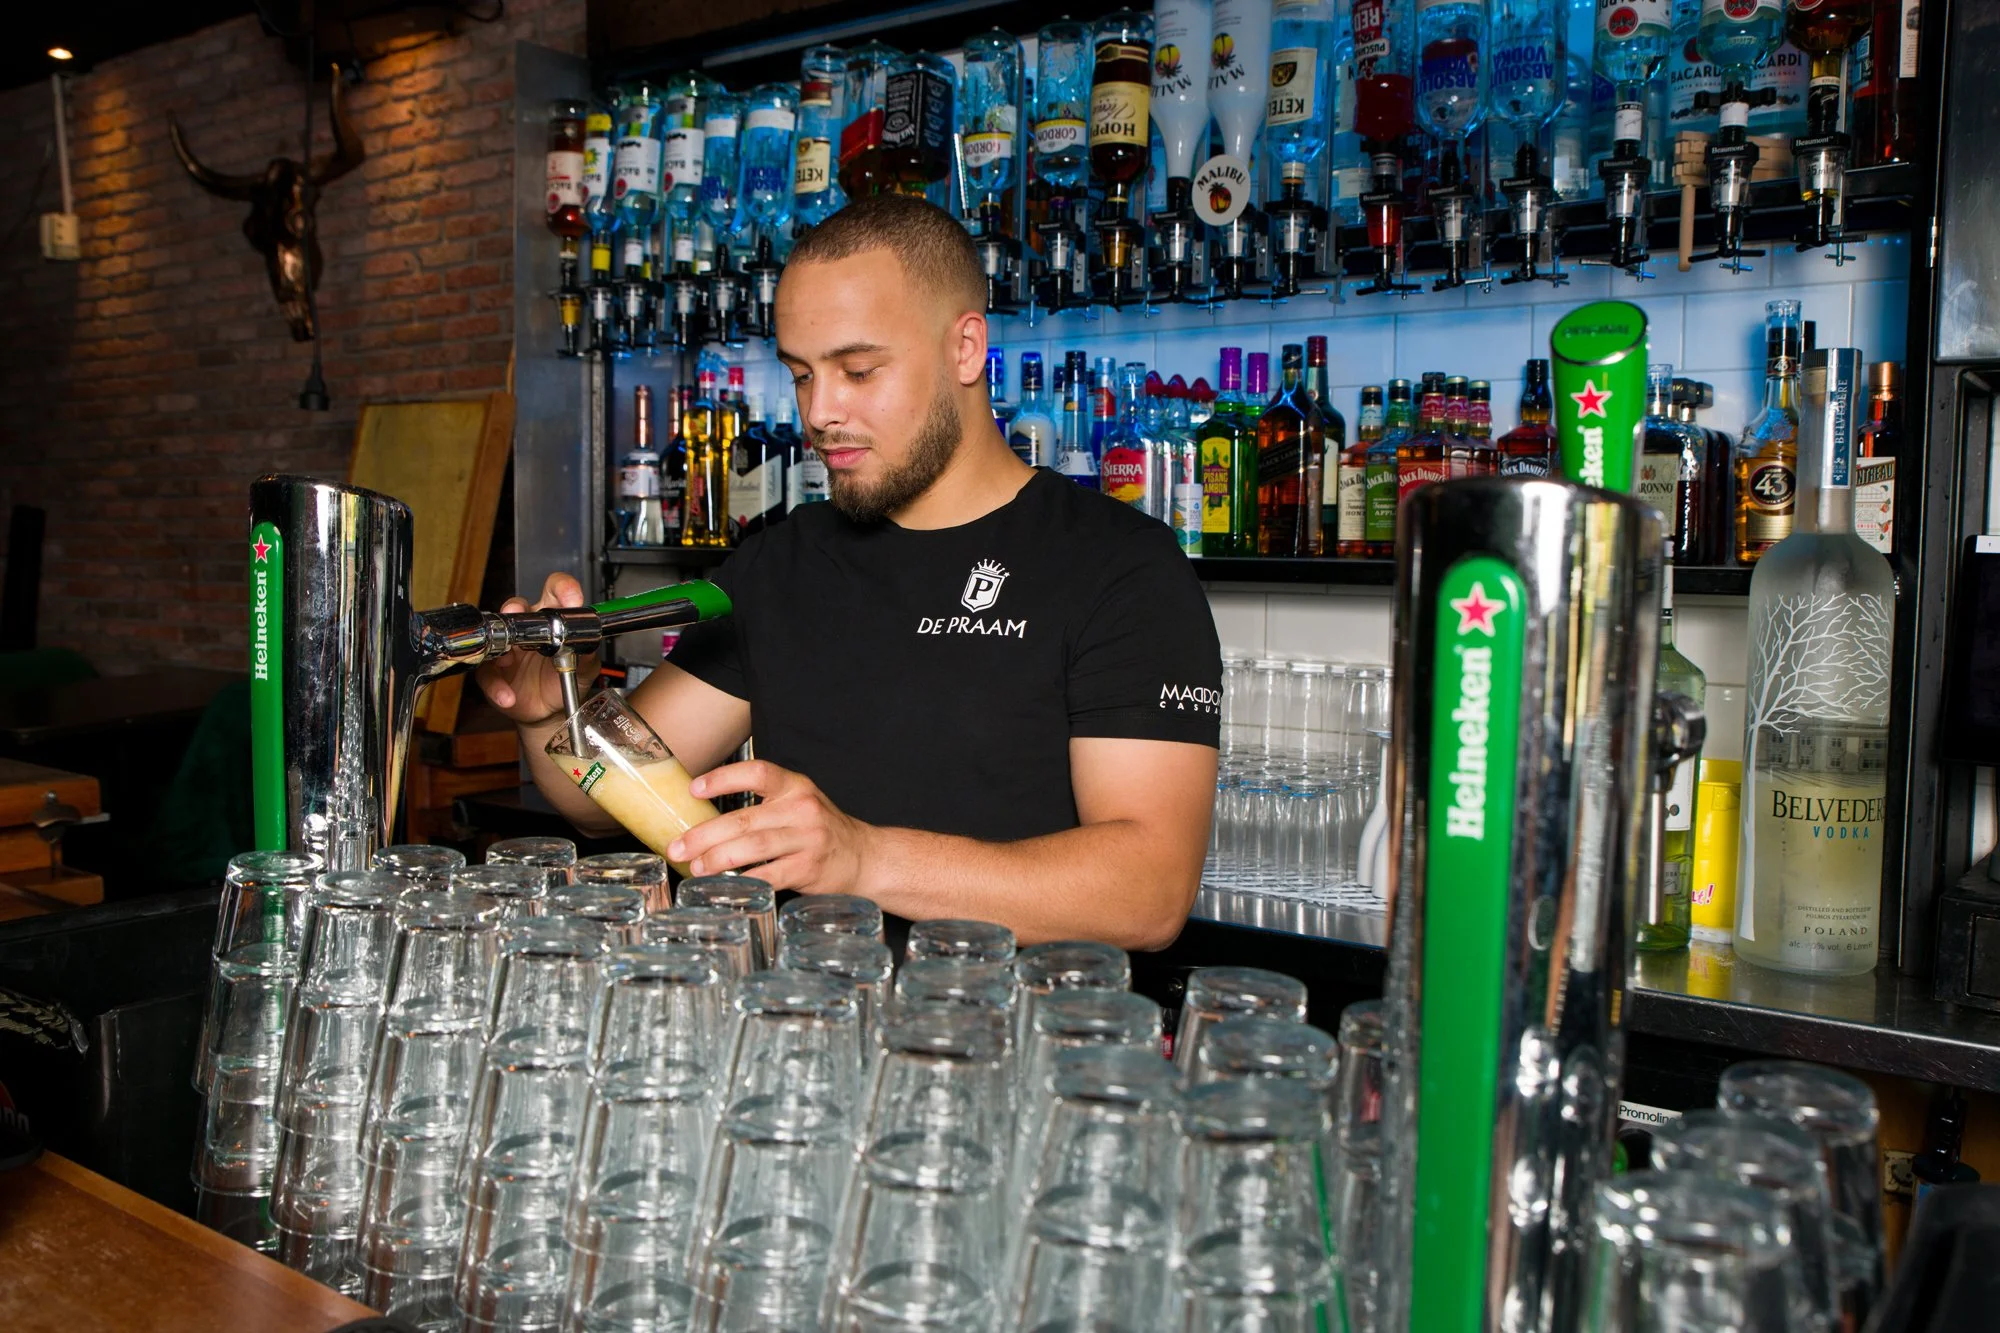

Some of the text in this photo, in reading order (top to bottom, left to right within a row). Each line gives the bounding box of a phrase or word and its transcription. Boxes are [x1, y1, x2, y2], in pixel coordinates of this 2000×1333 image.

[1354, 6, 1380, 27] RED
[1493, 46, 1547, 70] VODKA
[1753, 53, 1802, 70] CARDI
[1208, 64, 1246, 91] MALI
[1671, 64, 1721, 84] BACARD
[1150, 74, 1193, 98] MALI
[1036, 127, 1077, 142] GORDON
[1796, 137, 1829, 147] Beaumont
[963, 141, 1000, 156] GORDON
[1712, 144, 1745, 154] Beaumont
[796, 167, 823, 183] KETE
[1197, 166, 1246, 191] MALIBU
[1579, 426, 1605, 488] eken
[1103, 460, 1144, 477] SIERRA
[1203, 472, 1228, 483] PISANG
[1856, 463, 1894, 485] NTREAU
[1366, 473, 1384, 489] JACK
[1399, 470, 1417, 487] JACK
[1754, 473, 1789, 496] 43
[1203, 483, 1228, 494] AMBON
[1640, 482, 1673, 494] RONNO
[968, 577, 994, 601] P
[254, 570, 268, 681] Heineken
[916, 616, 1028, 639] DE PRAAM
[1160, 700, 1219, 715] CASUA
[1446, 645, 1492, 842] Heineken
[581, 767, 603, 792] ineken
[1771, 789, 1886, 823] BELVEDER
[1813, 826, 1869, 839] VODKA
[1803, 925, 1868, 936] POLAND
